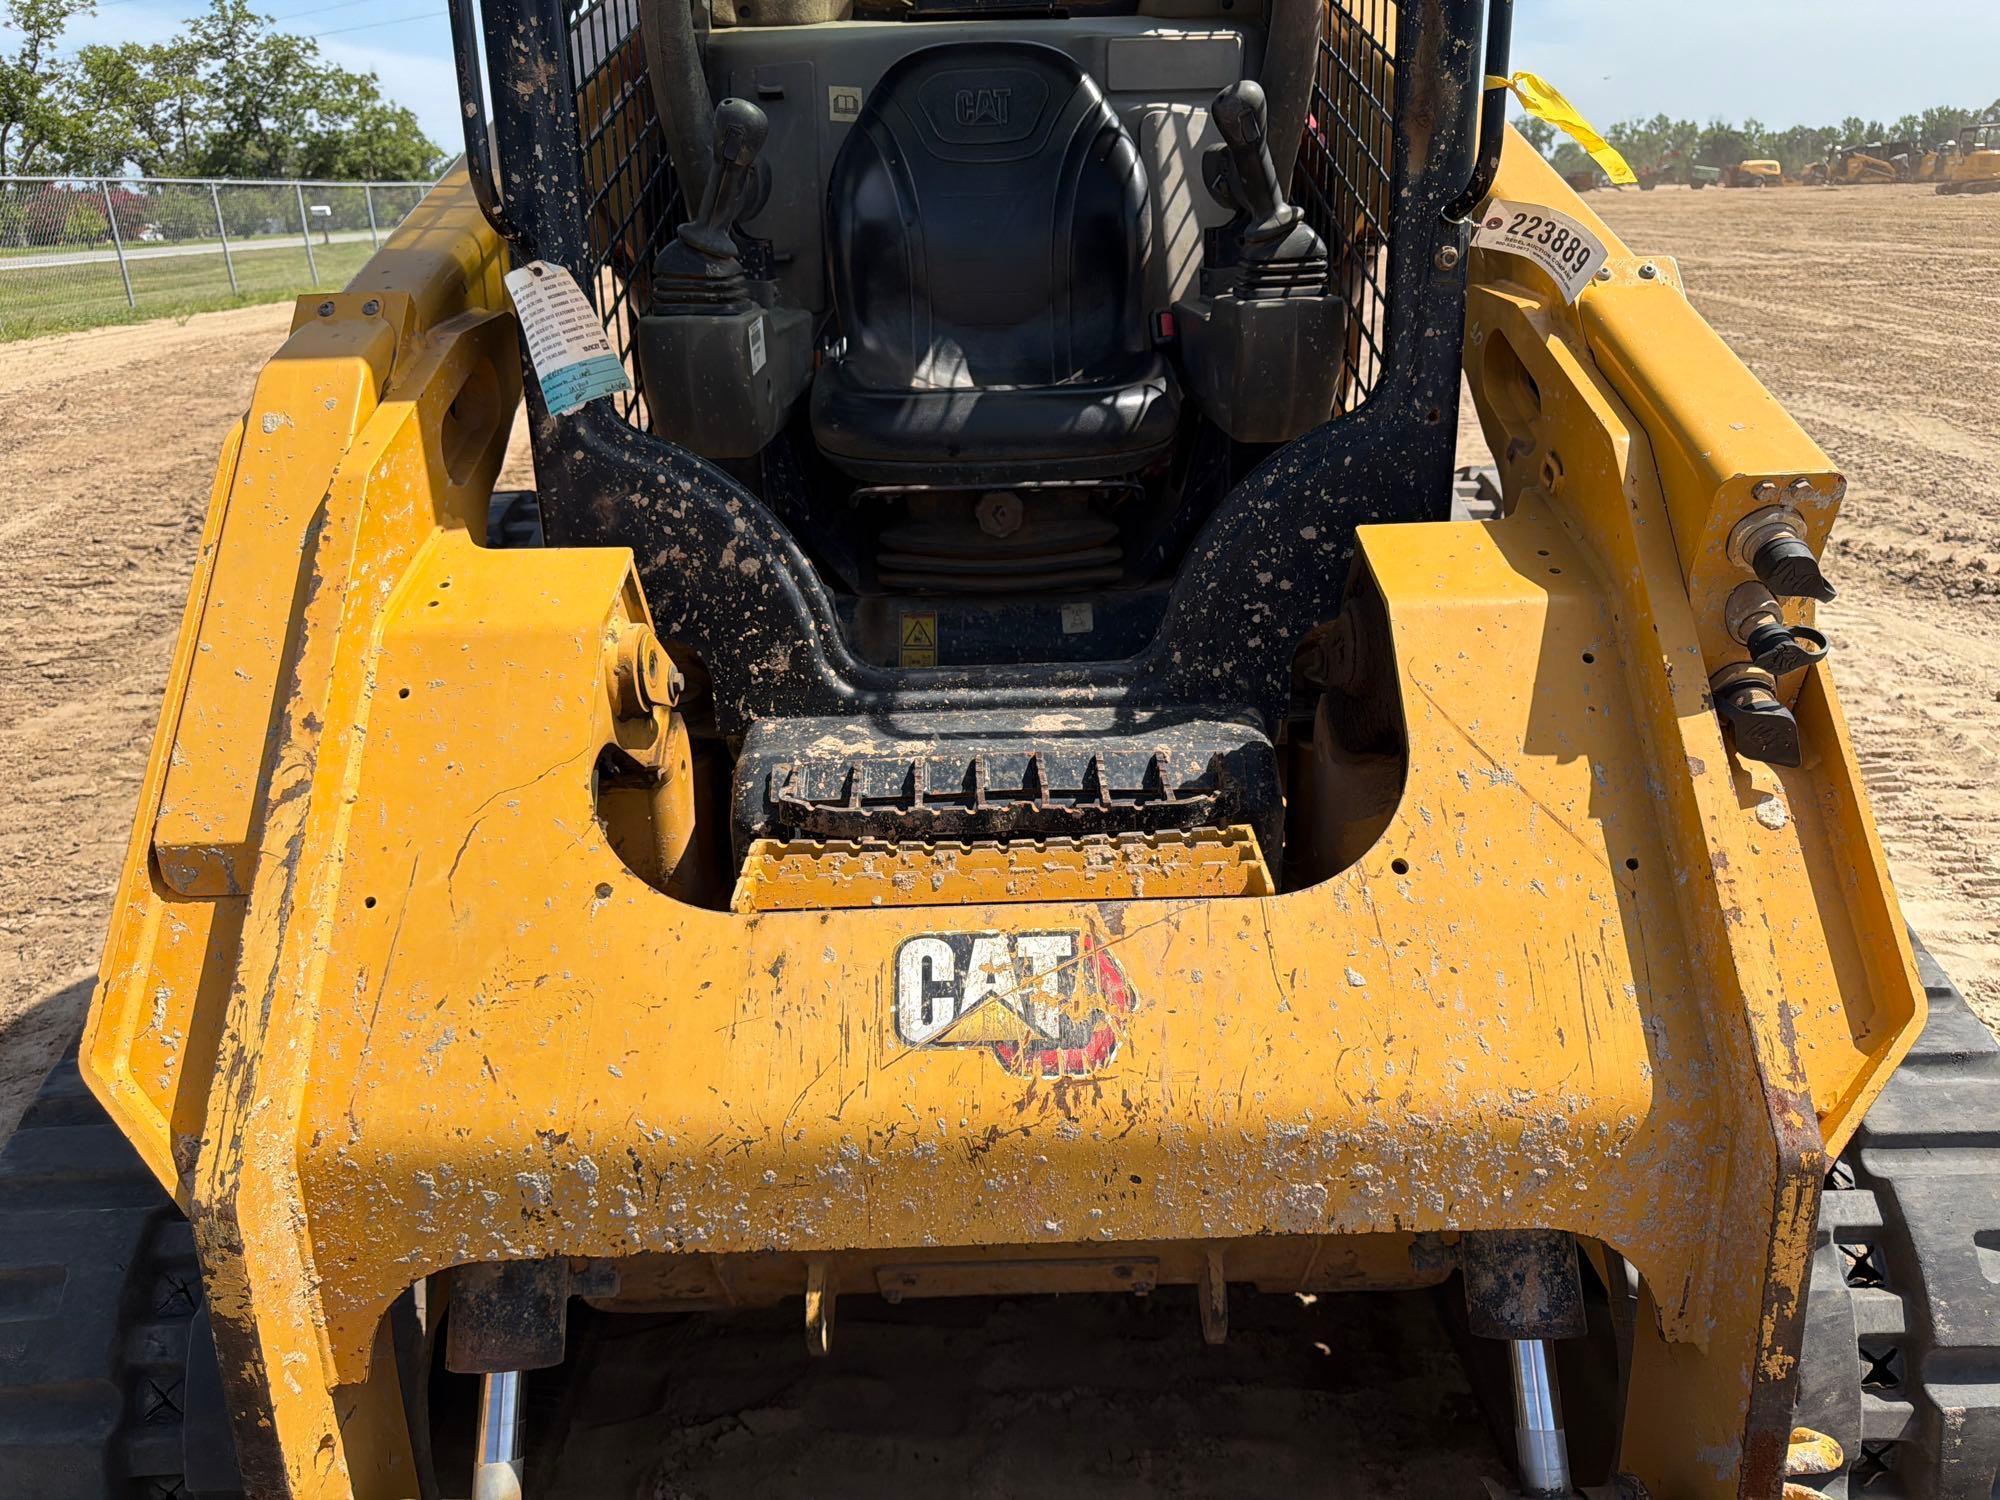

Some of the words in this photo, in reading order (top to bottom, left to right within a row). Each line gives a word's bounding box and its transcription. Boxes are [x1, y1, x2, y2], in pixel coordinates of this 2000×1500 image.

[954, 88, 1012, 127] CAT
[1507, 213, 1591, 274] 223889
[1526, 242, 1551, 258] AUCTION
[1551, 257, 1574, 282] COMPANY
[899, 935, 1072, 1043] CAT
